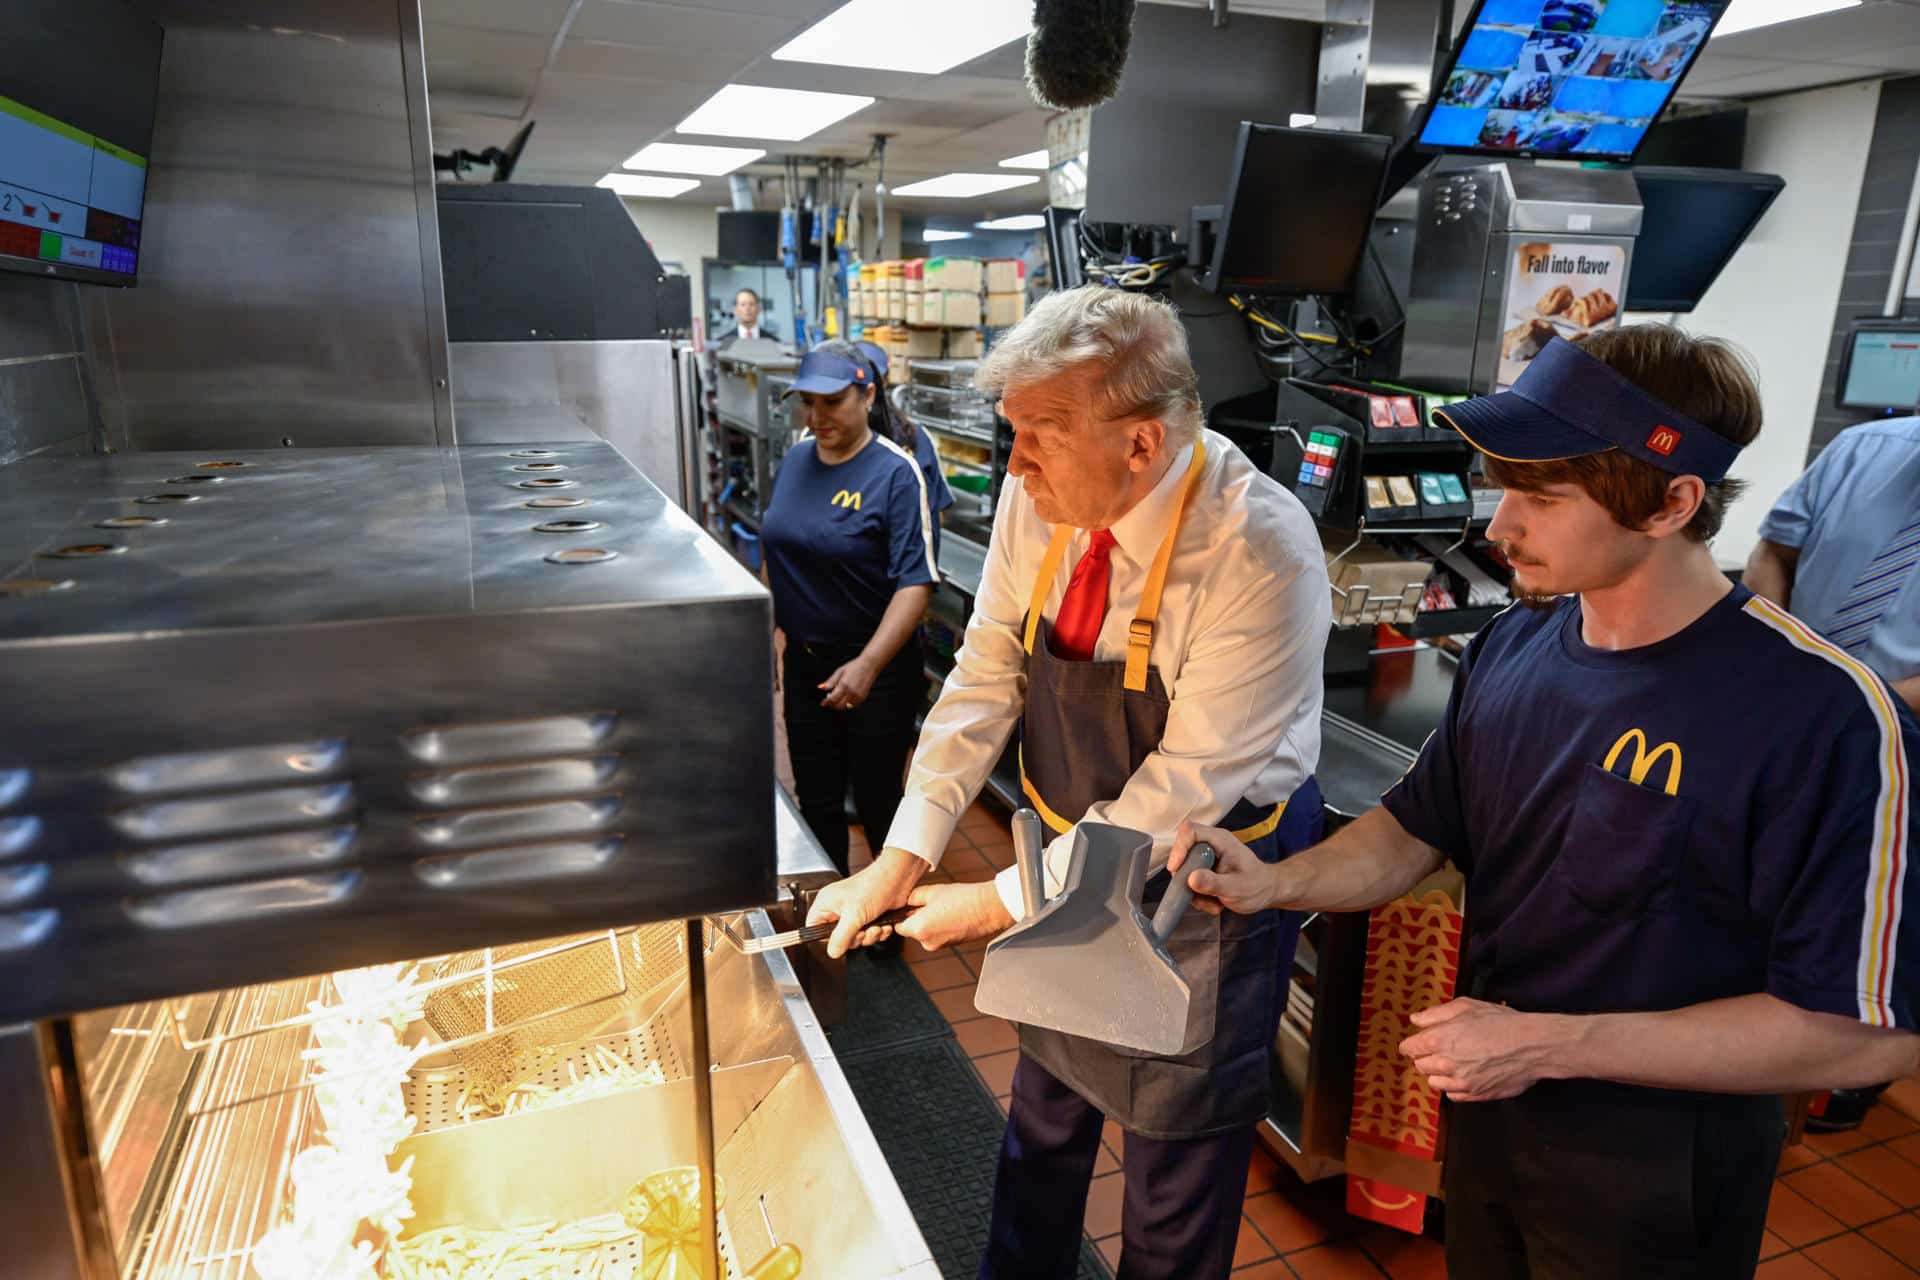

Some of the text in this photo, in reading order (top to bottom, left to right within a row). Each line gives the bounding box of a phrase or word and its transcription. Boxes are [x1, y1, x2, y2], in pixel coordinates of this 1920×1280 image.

[3, 193, 12, 212] 2
[1527, 254, 1610, 275] Fall into flavor
